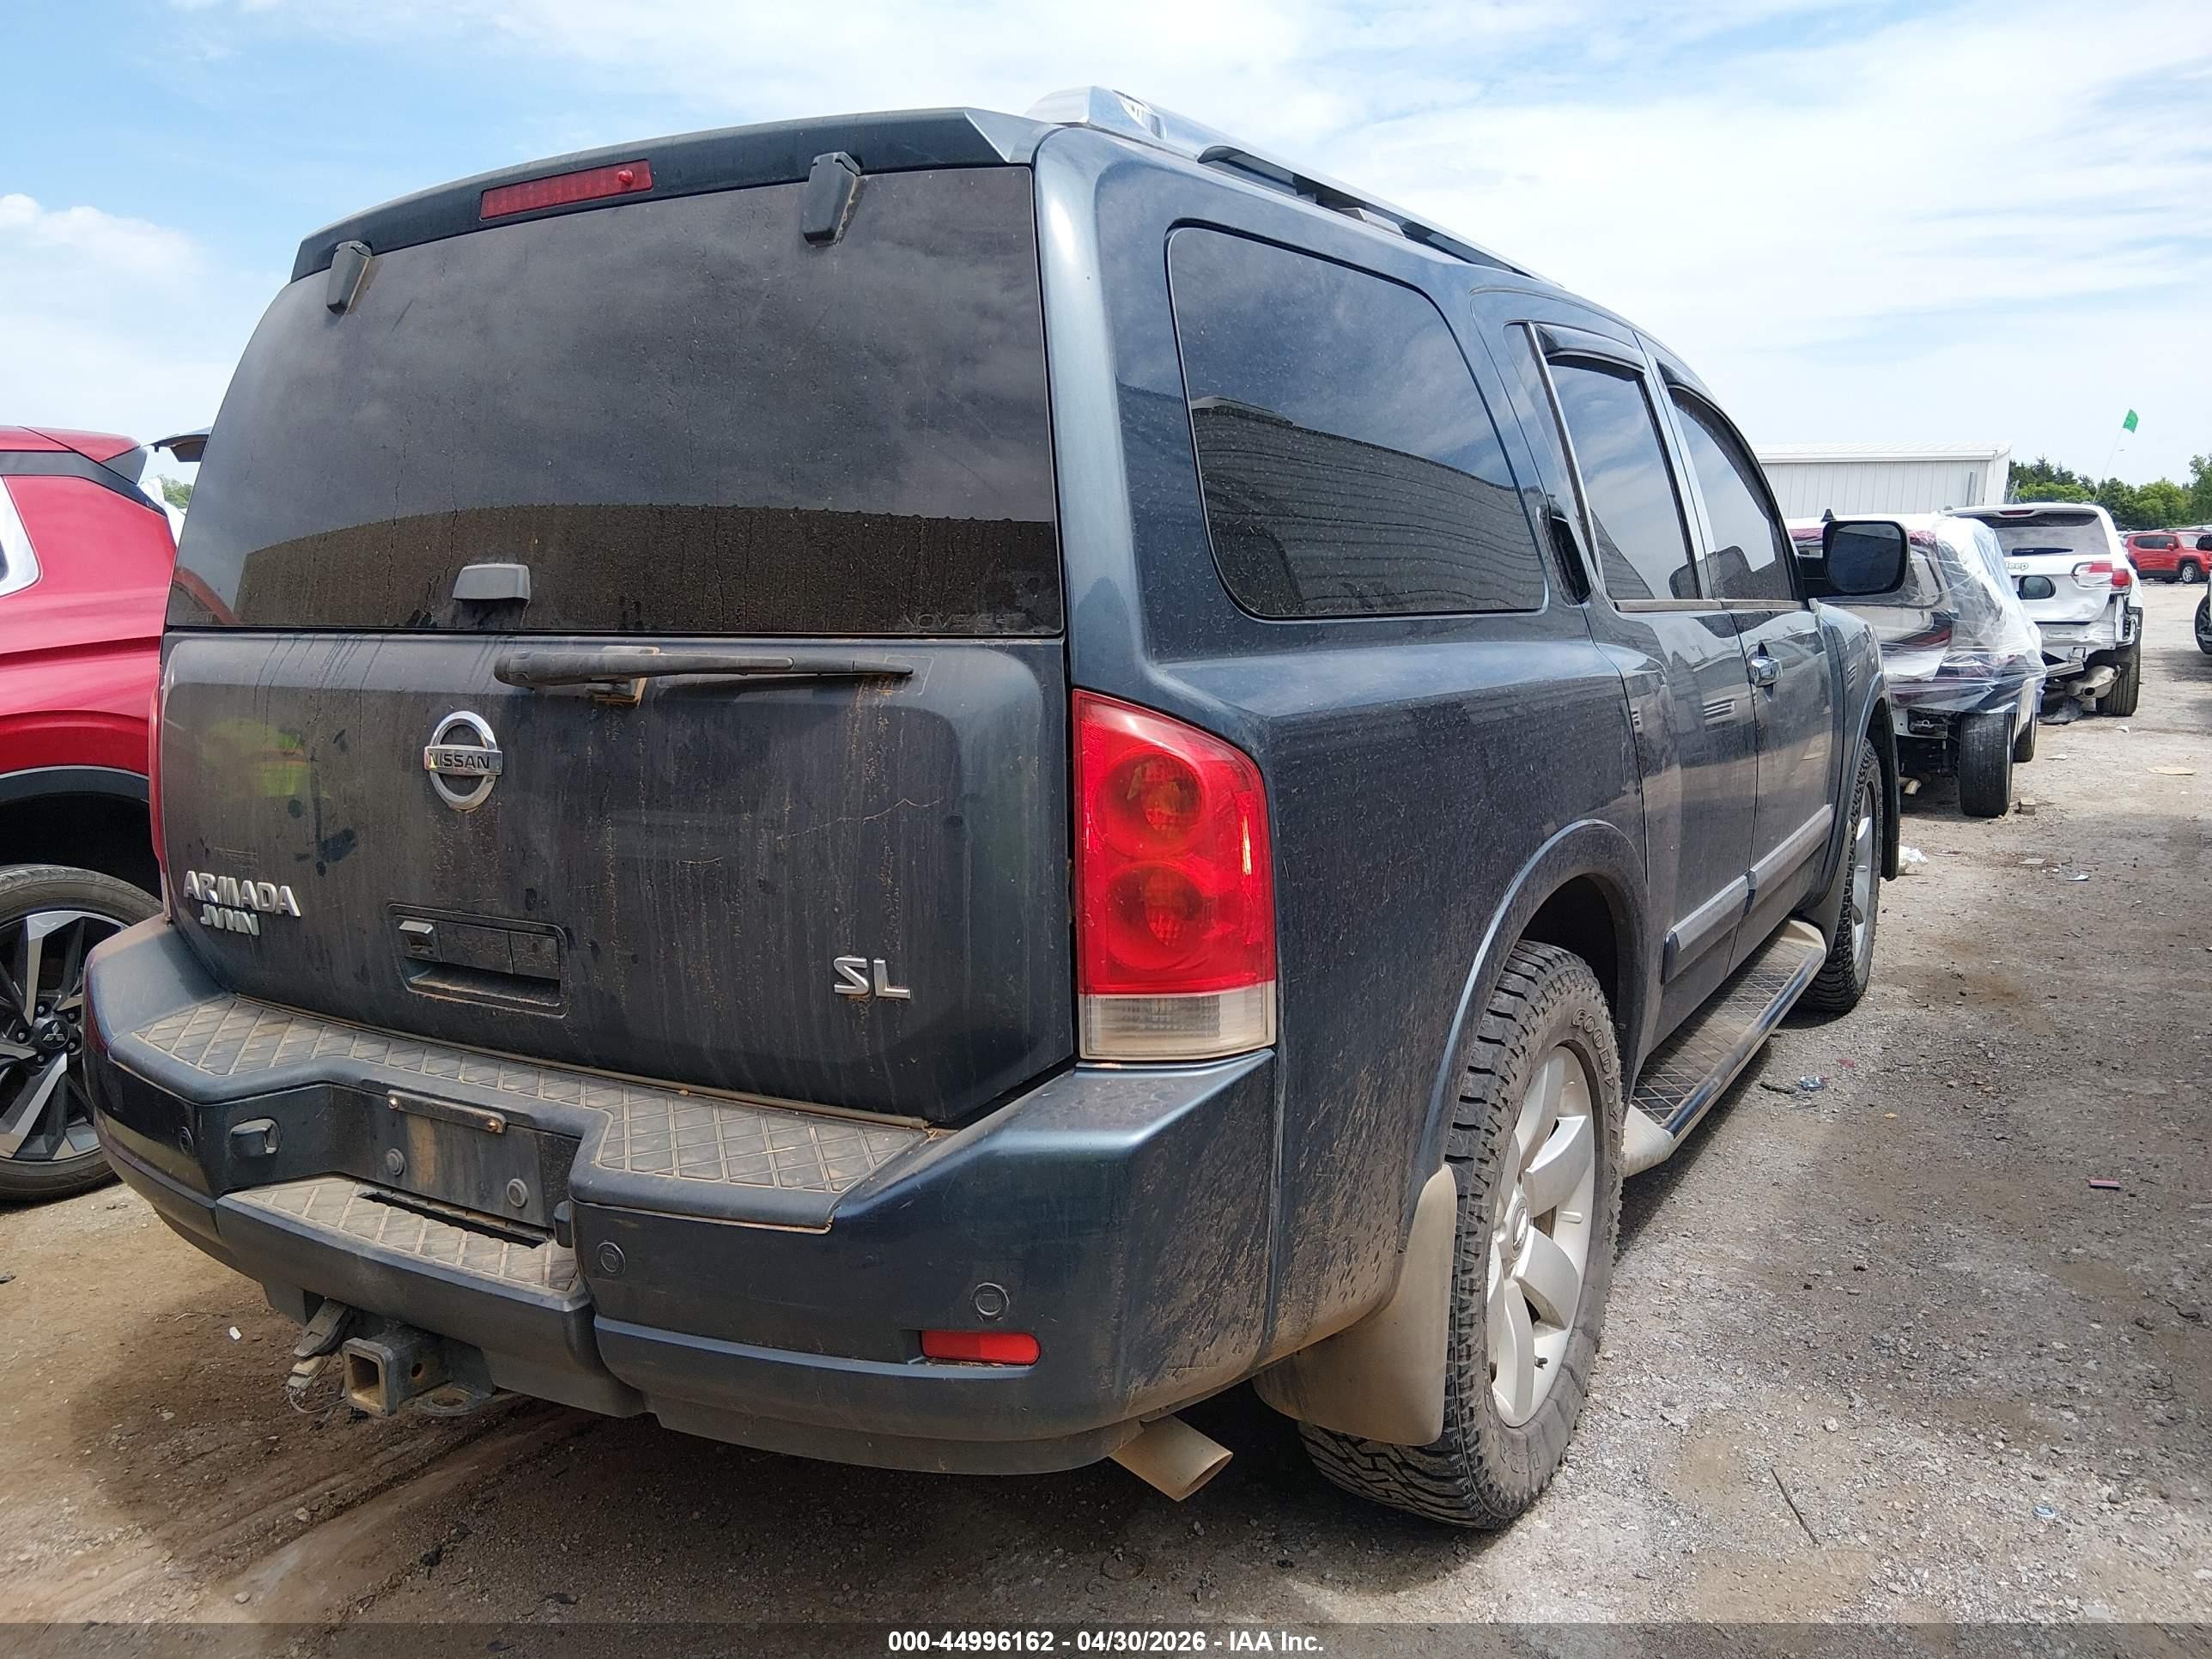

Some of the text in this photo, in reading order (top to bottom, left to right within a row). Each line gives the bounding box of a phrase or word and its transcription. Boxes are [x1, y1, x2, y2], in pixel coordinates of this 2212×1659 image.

[429, 752, 490, 769] NISSAN
[183, 870, 301, 917] ARMADA
[833, 955, 911, 1000] SL
